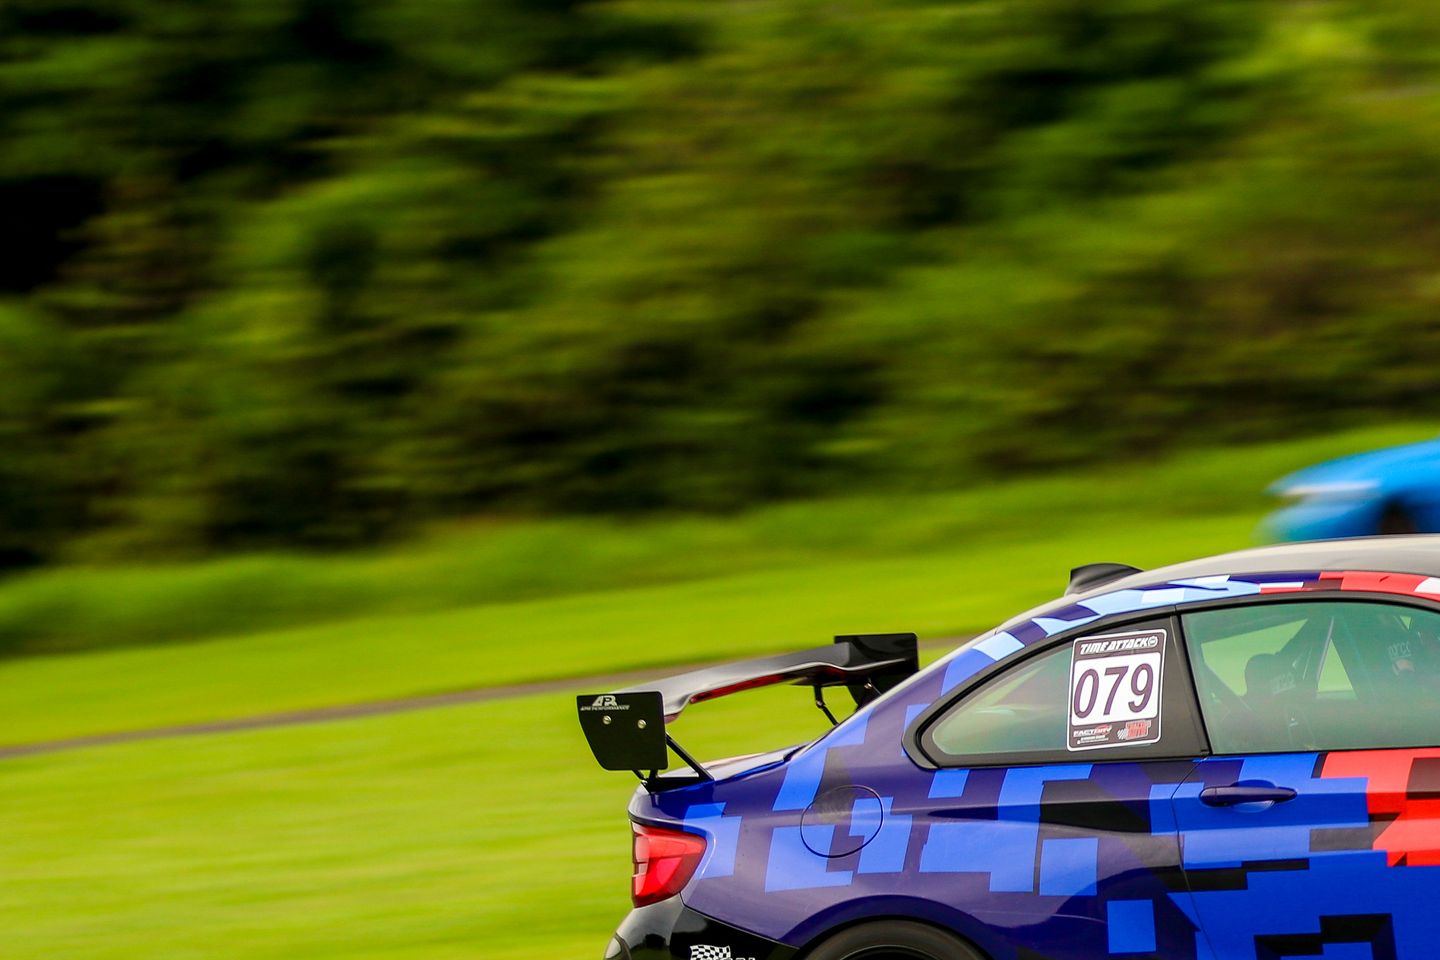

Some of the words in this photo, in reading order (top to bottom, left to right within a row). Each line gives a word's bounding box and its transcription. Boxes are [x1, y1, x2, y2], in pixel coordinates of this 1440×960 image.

[1080, 643, 1107, 655] TIME
[1107, 637, 1148, 651] ATTACK
[1073, 663, 1154, 718] 079
